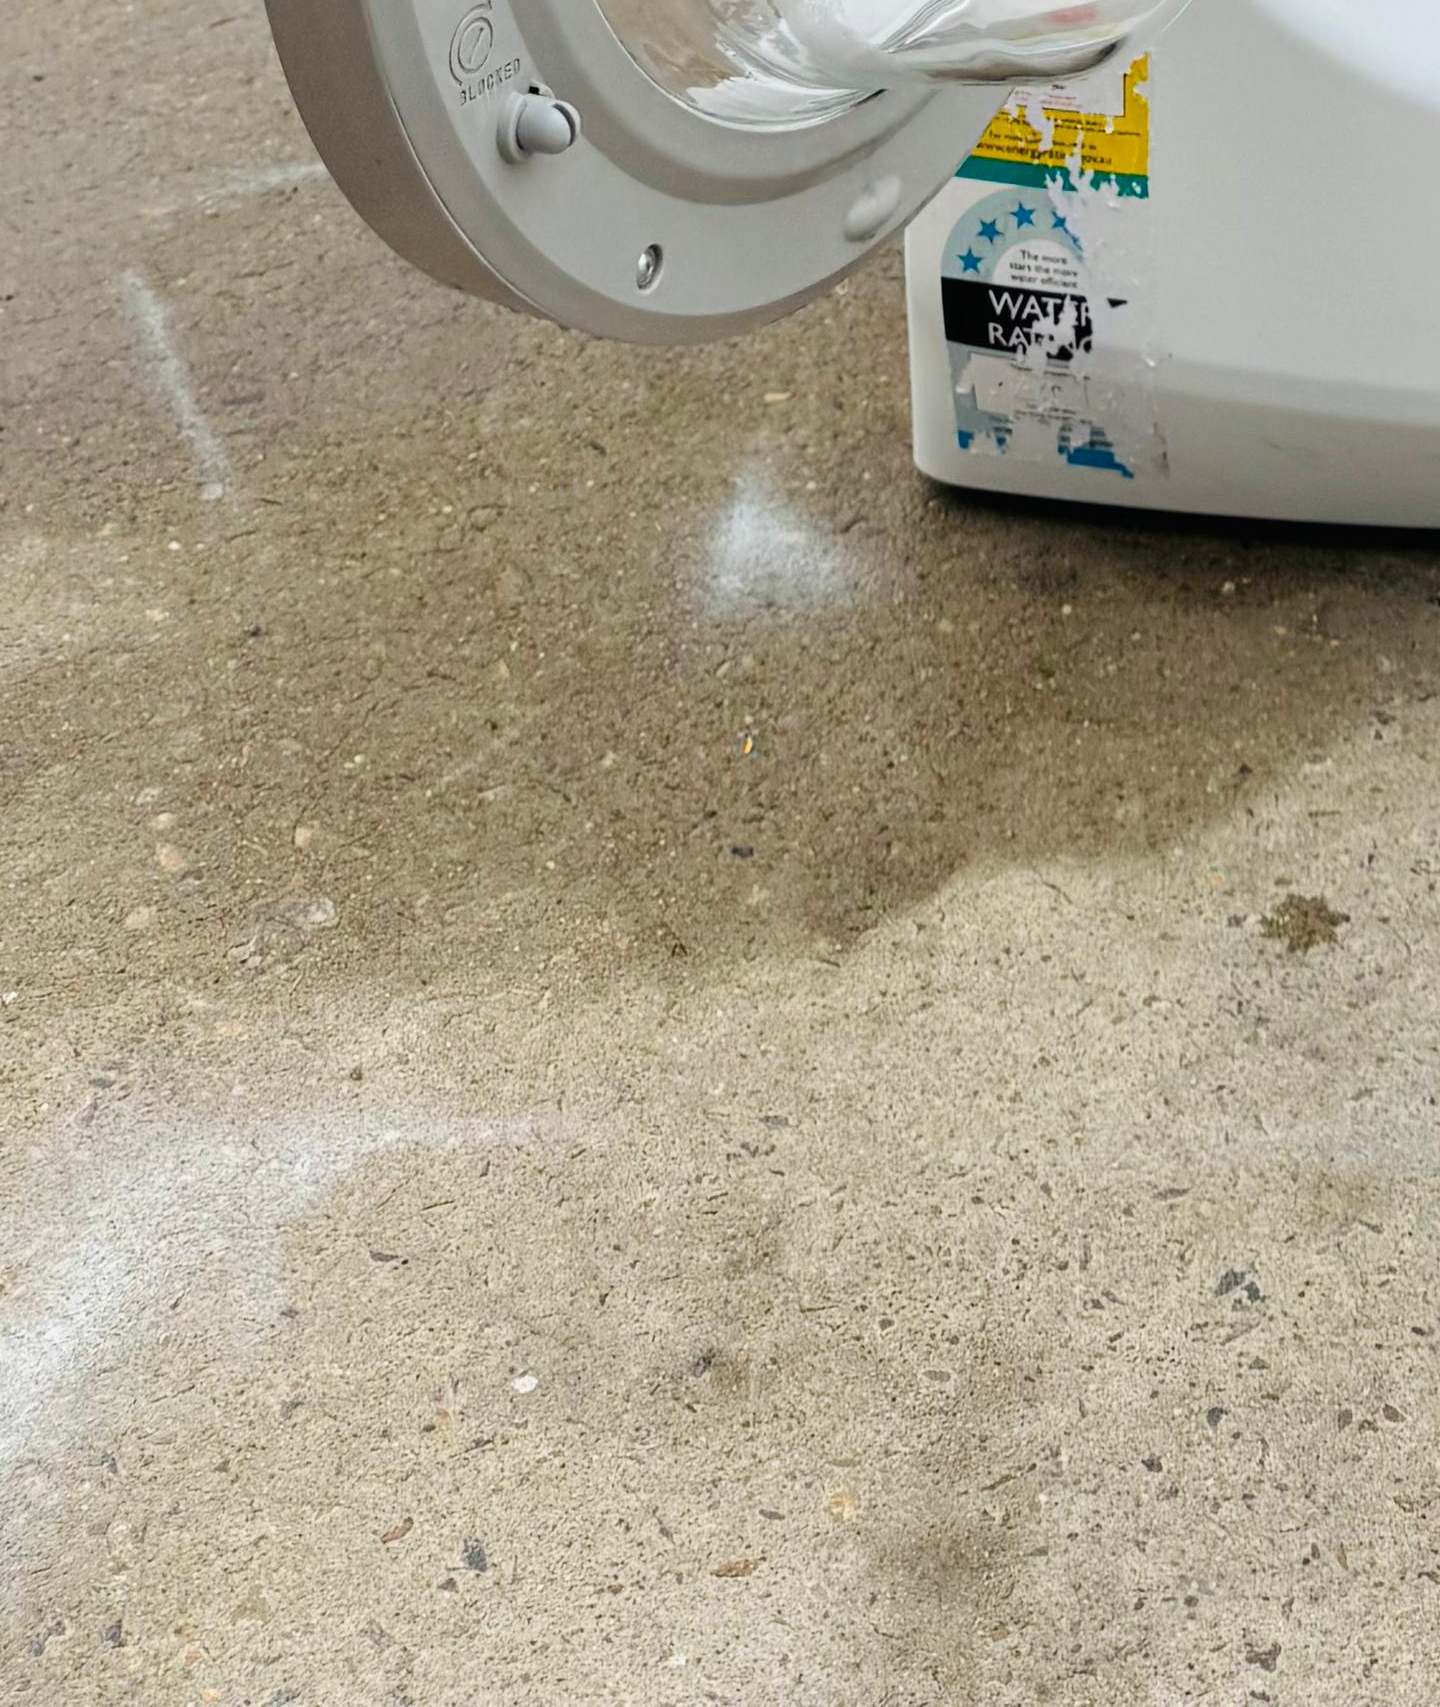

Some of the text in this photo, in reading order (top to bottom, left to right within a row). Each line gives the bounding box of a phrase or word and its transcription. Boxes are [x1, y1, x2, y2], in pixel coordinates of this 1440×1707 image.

[460, 58, 520, 106] BLOCKED
[1020, 249, 1068, 265] The more
[988, 289, 1089, 328] WATR
